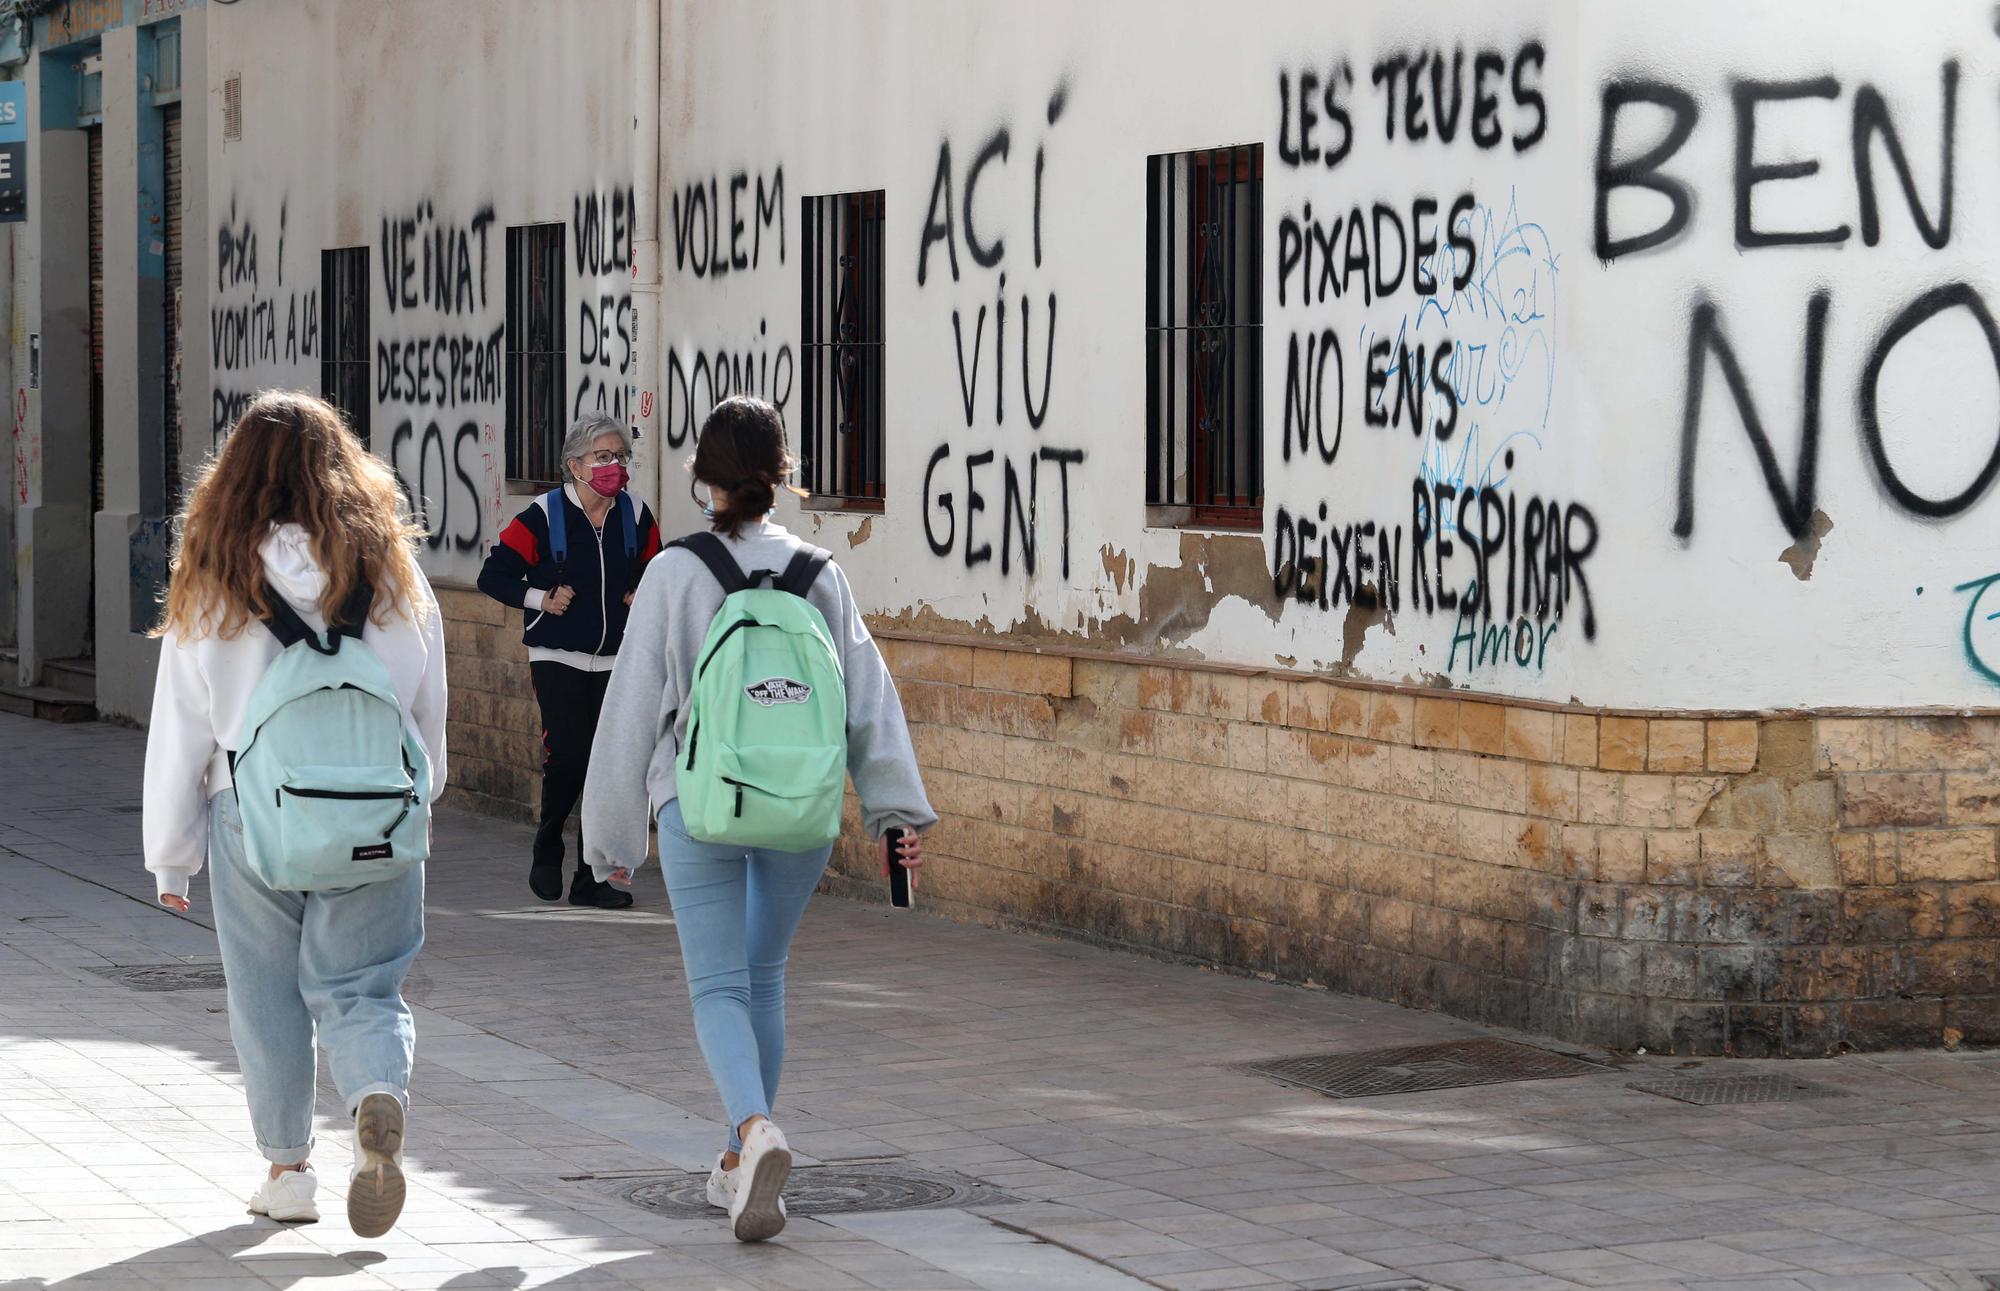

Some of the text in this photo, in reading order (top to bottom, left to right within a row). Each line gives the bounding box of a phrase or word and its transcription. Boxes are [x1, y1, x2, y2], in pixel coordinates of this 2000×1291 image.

[1279, 63, 1353, 168] LES
[1593, 54, 1998, 269] BEN
[673, 165, 786, 280] VOLEM
[917, 80, 1070, 286] ACÍ
[286, 293, 297, 365] A
[301, 289, 318, 360] LA
[378, 322, 505, 408] DESESPERAT
[580, 294, 632, 376] DES
[1283, 328, 1343, 465] NO
[1365, 339, 1459, 441] ENS
[1672, 281, 2000, 547] NO
[923, 442, 1085, 581] GENT
[1412, 449, 1599, 642] RESPIRAR
[1448, 579, 1557, 673] Amor
[764, 680, 787, 690] VANS
[769, 688, 786, 698] THE
